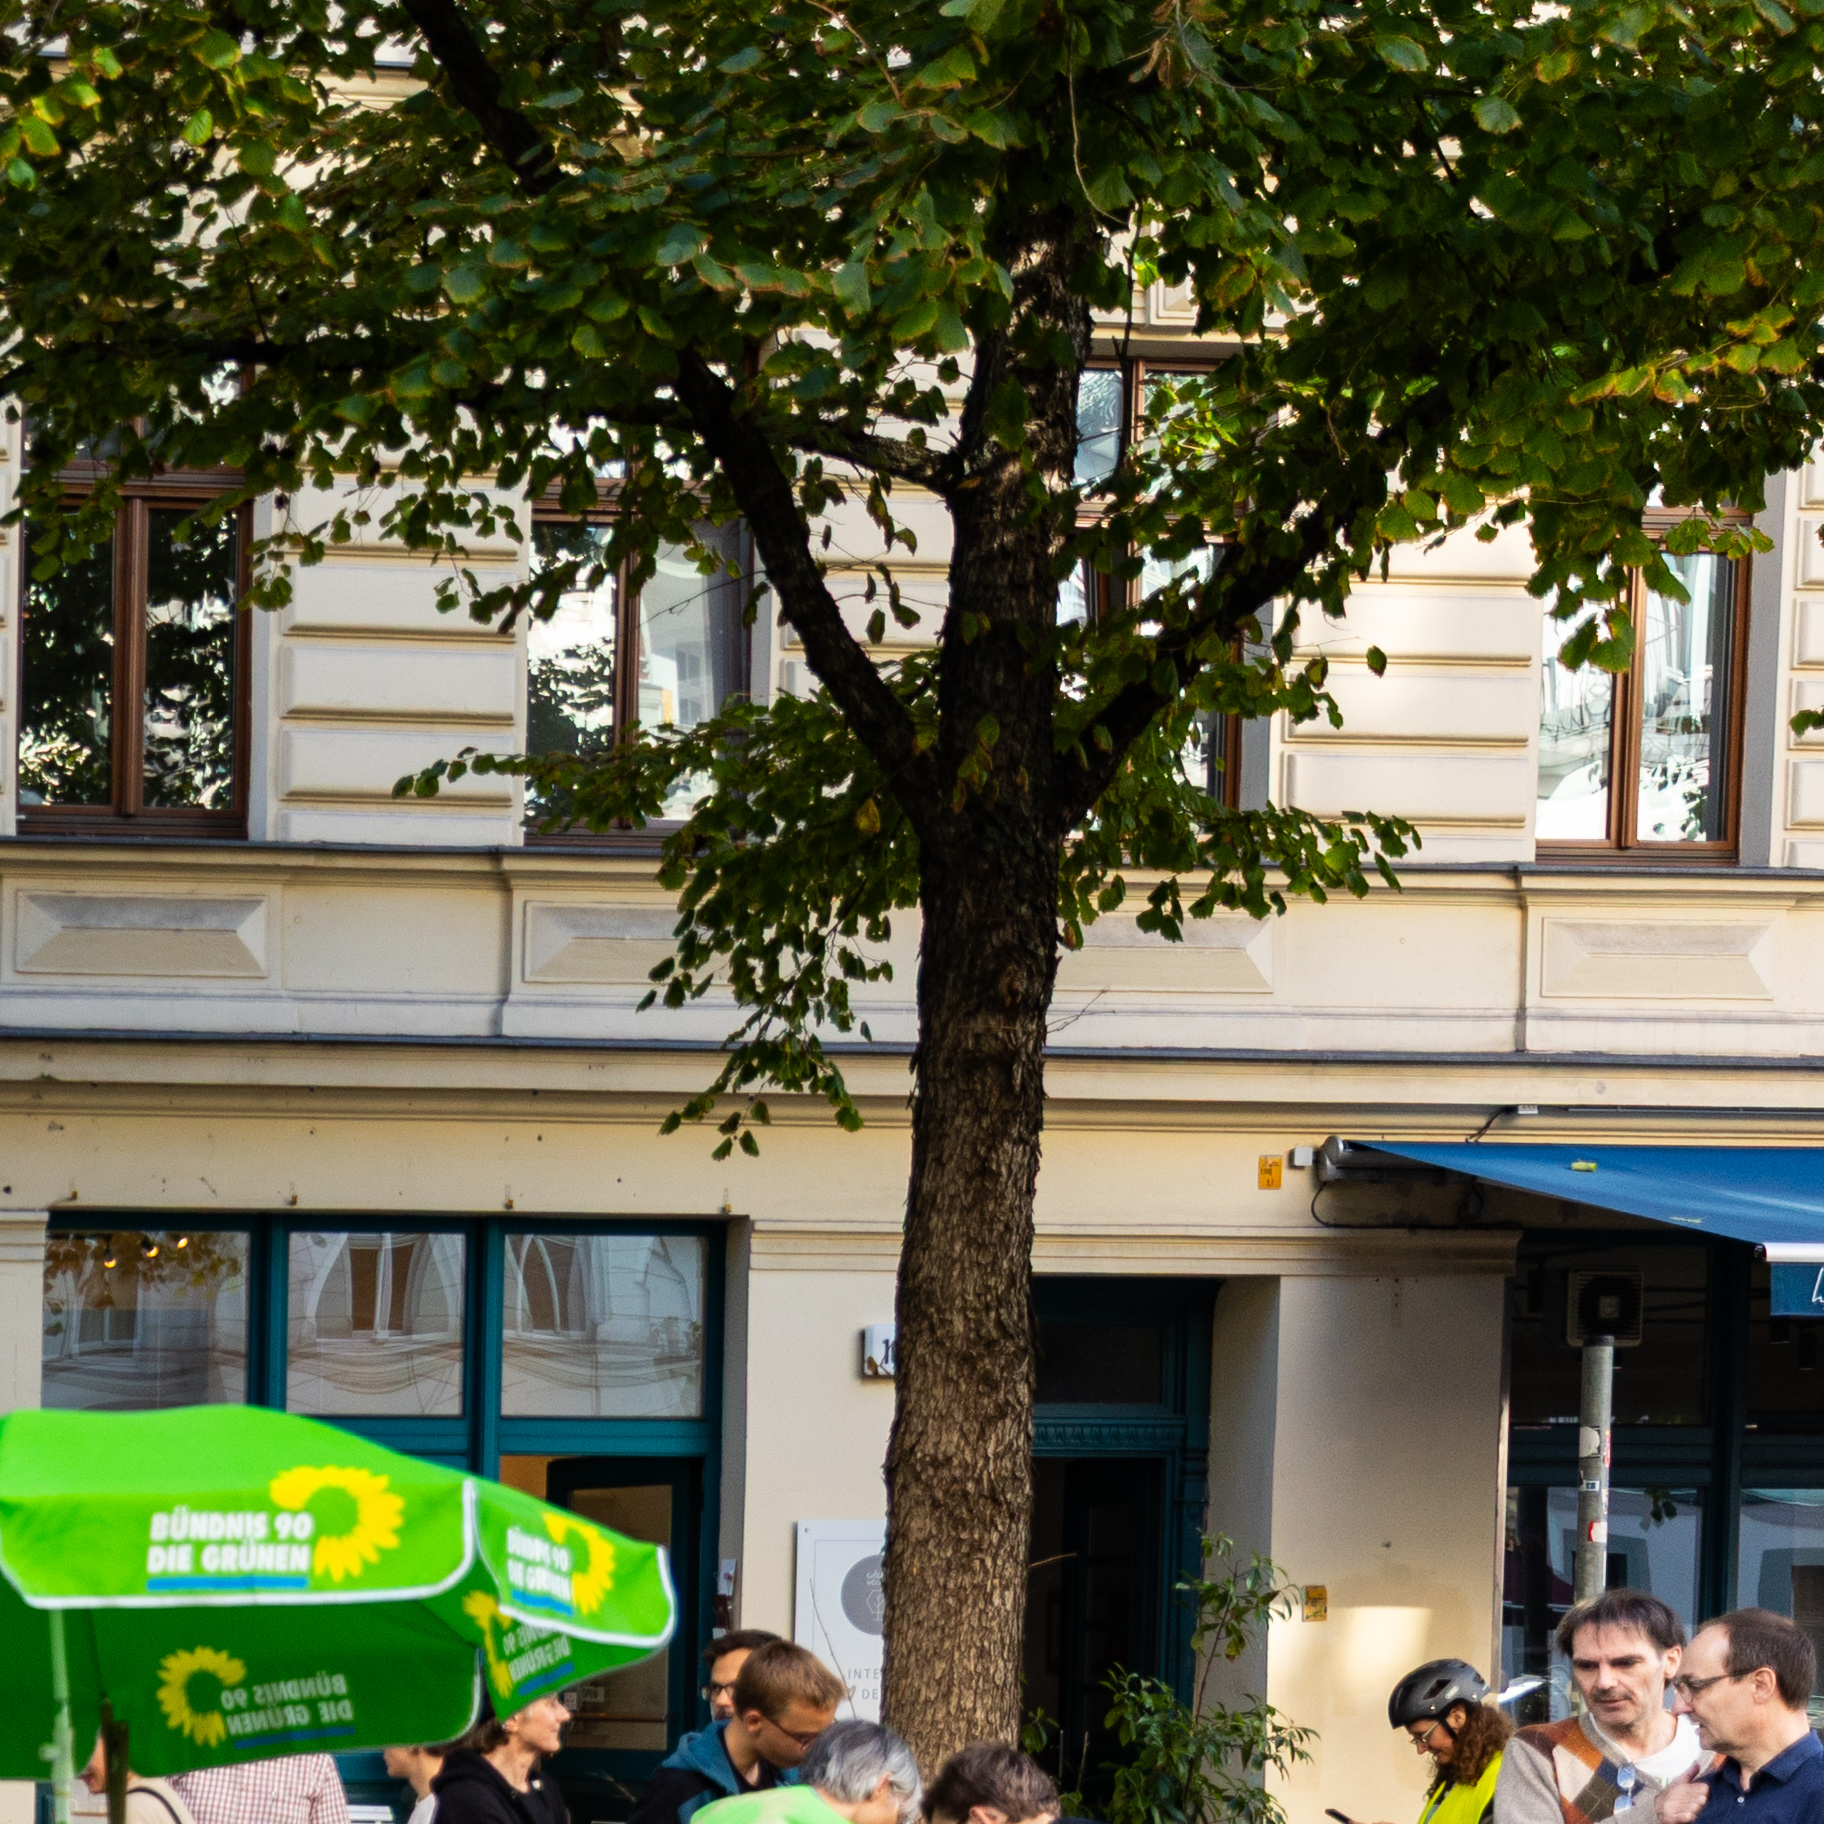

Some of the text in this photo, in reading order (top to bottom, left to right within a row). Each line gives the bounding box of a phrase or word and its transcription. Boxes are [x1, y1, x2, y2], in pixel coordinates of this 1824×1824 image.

[150, 1504, 315, 1541] BÜNDNIS 90
[147, 1539, 310, 1573] DIE GRÜNEN
[552, 1546, 571, 1573] 90
[847, 1668, 880, 1680] INTE
[861, 1689, 879, 1700] DE
